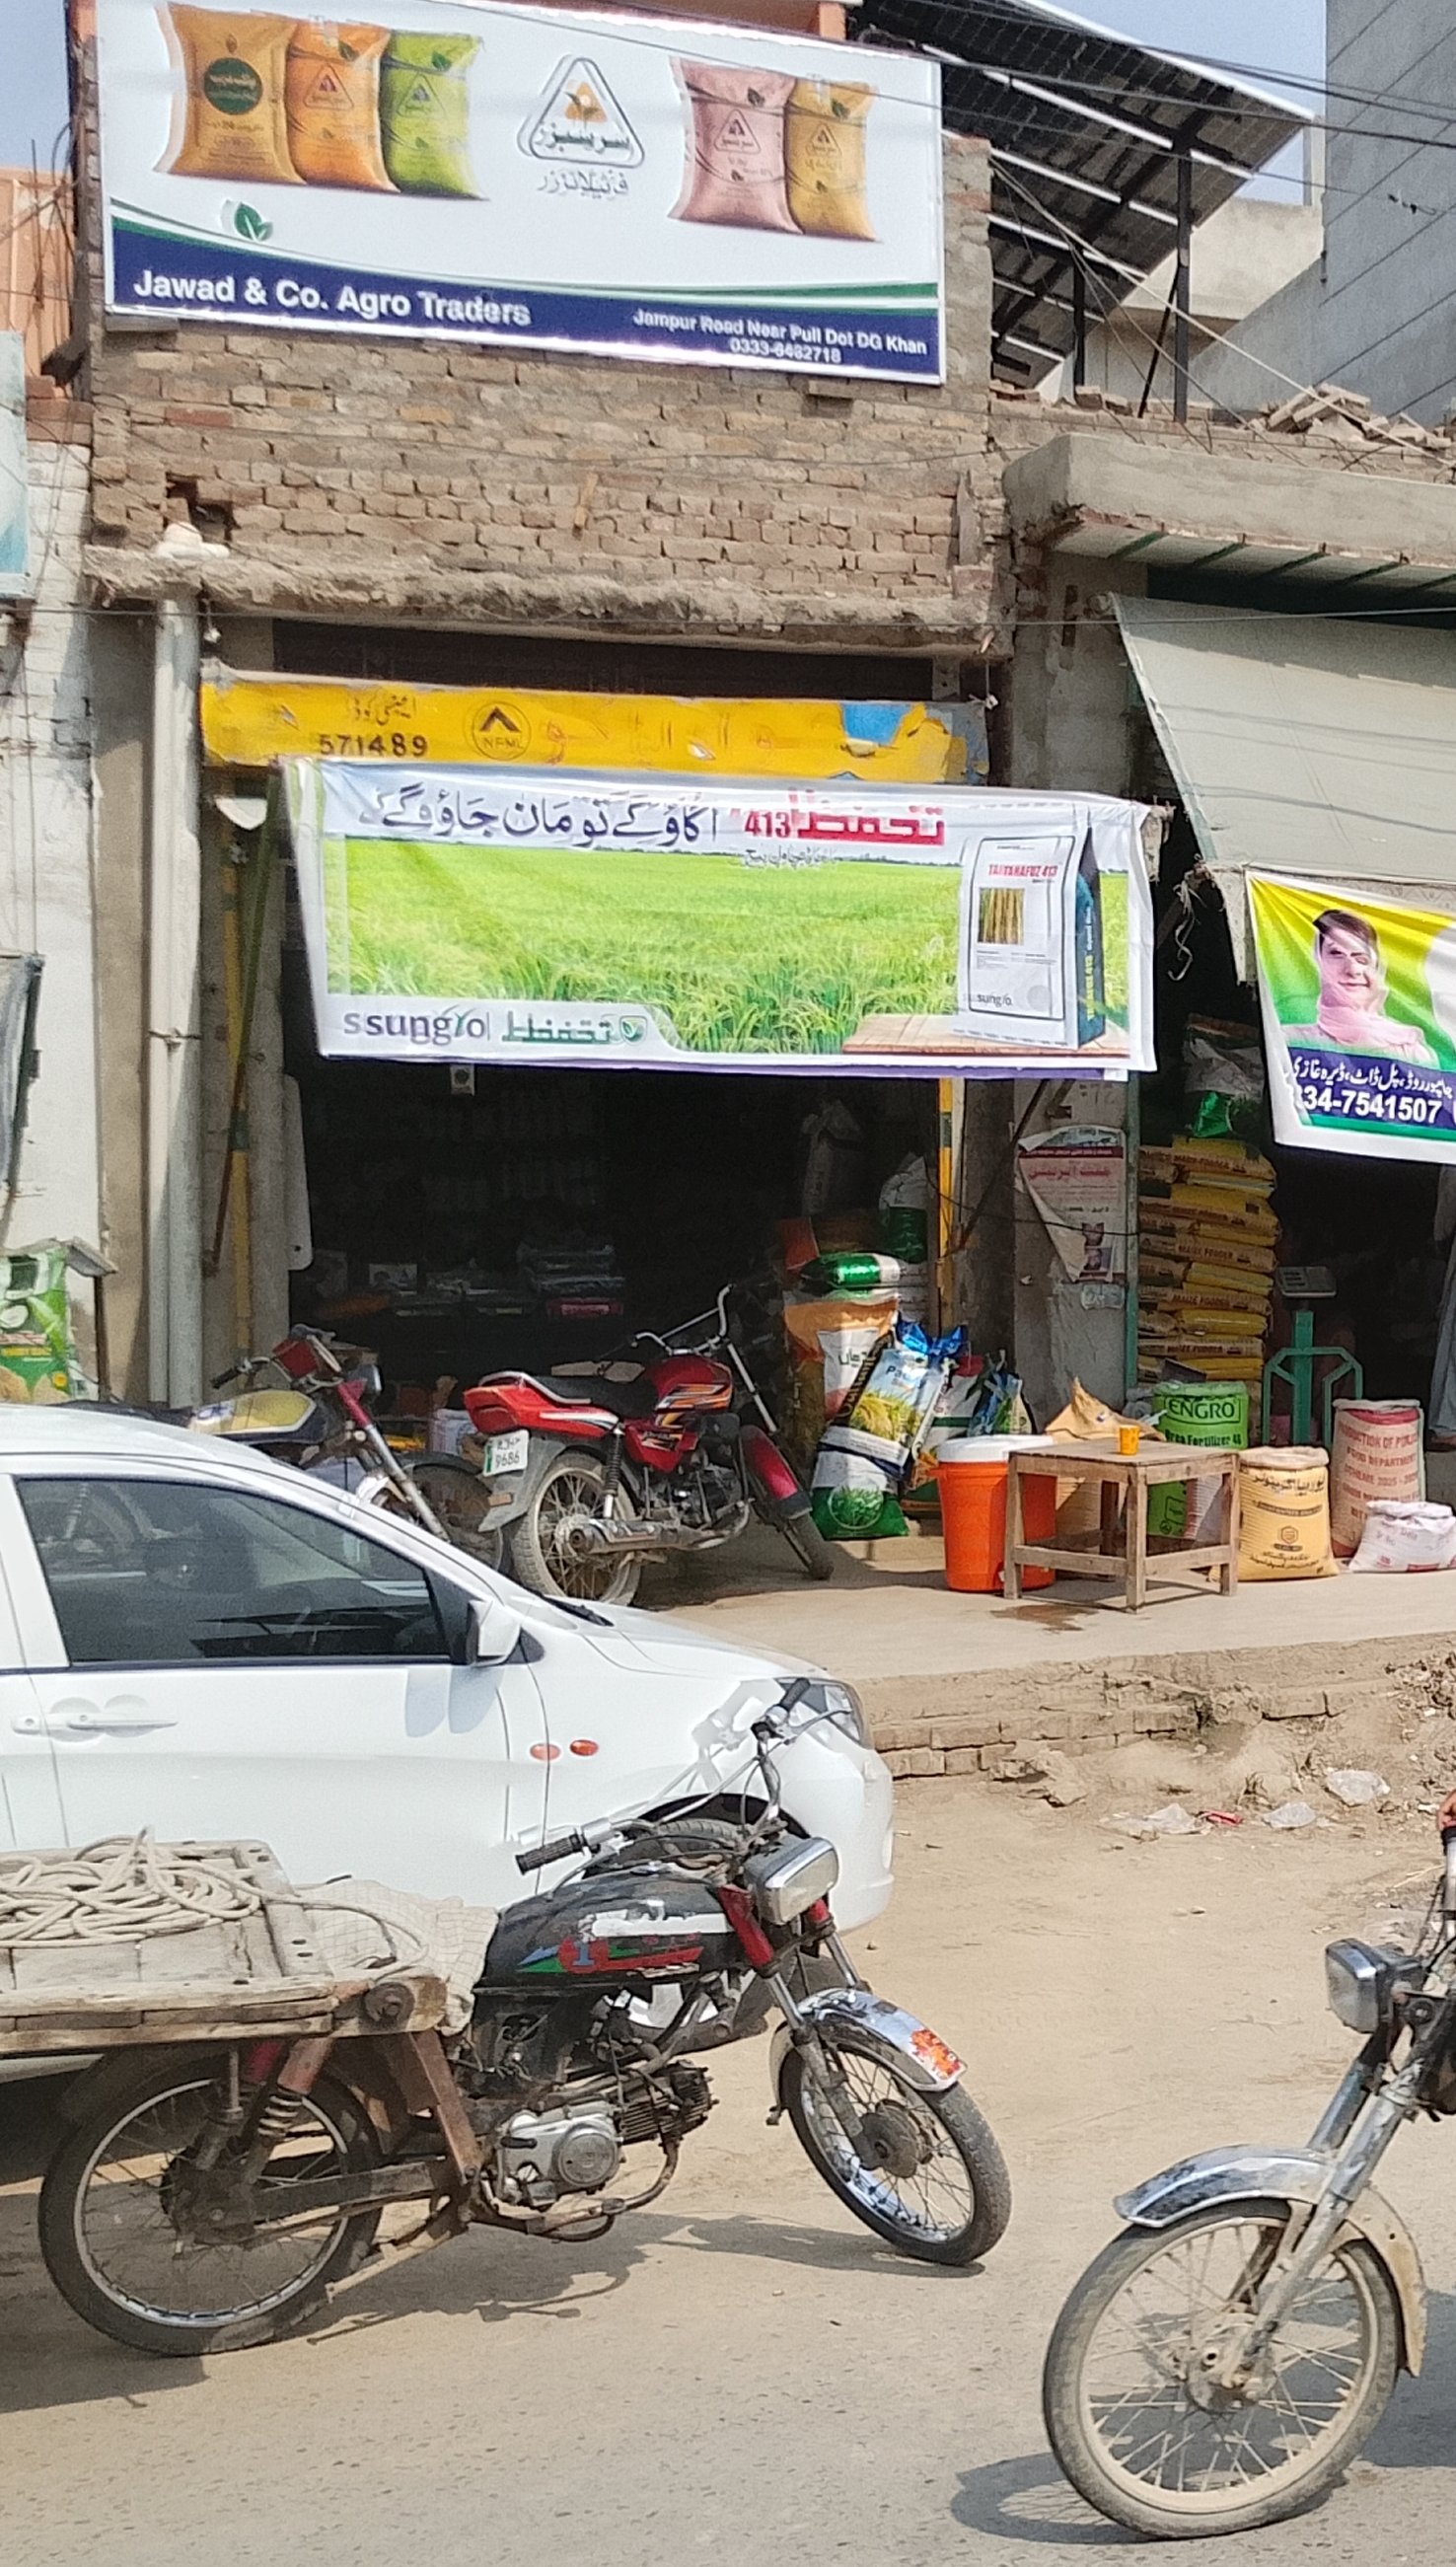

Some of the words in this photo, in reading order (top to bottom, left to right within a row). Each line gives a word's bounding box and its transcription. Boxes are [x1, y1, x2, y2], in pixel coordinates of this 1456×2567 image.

[133, 269, 236, 303] Jawad
[245, 276, 268, 305] &
[276, 278, 328, 310] Co.
[336, 285, 410, 320] Agro
[416, 291, 532, 327] Traders
[633, 309, 696, 333] Jampur
[699, 316, 744, 335] Road
[748, 320, 786, 338] Near
[790, 324, 821, 343] Pull
[826, 329, 853, 346] Dot
[857, 331, 882, 350] DG
[886, 336, 927, 355] Khan
[320, 733, 428, 758] 571489
[744, 807, 790, 839] 413
[1168, 1399, 1235, 1419] ENGRO
